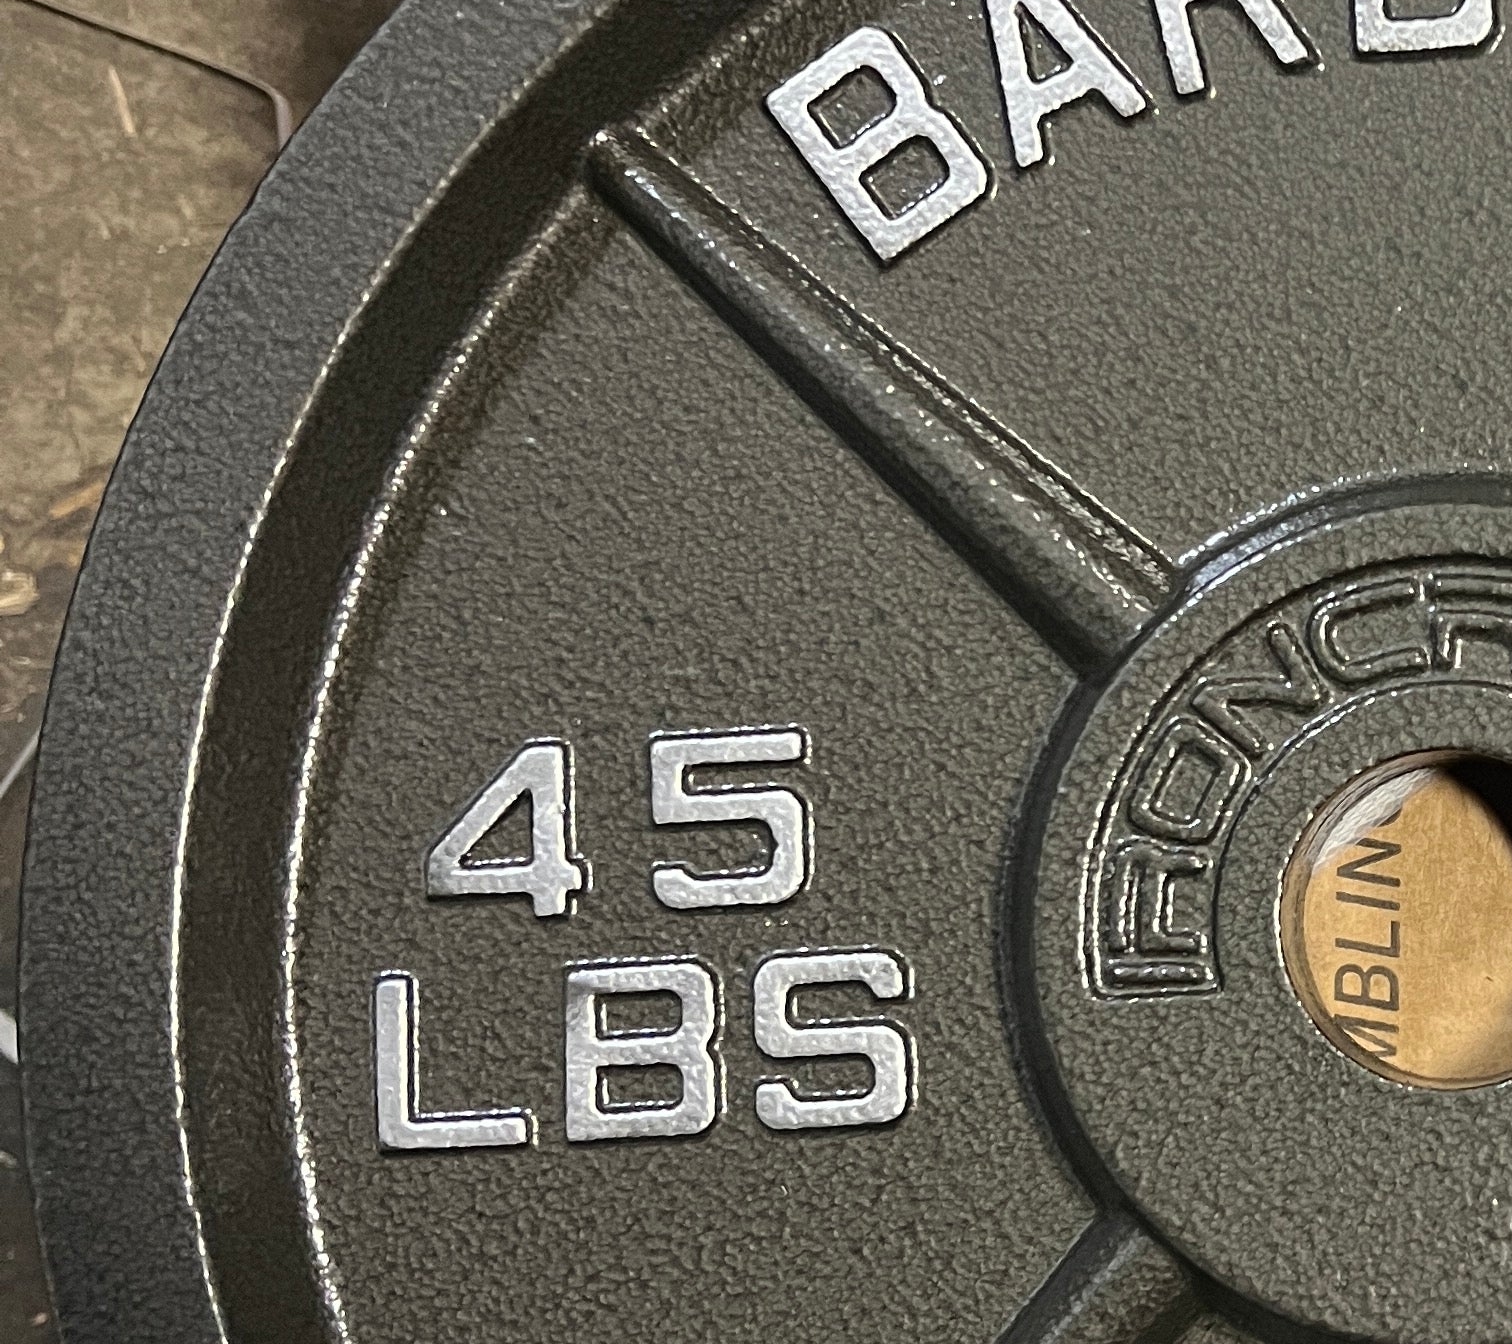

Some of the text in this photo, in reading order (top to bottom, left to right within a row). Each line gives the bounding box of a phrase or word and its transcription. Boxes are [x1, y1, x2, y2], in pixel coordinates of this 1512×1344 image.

[426, 728, 813, 917] 45
[1334, 809, 1402, 1058] MBLIN
[374, 949, 915, 1150] LBS
